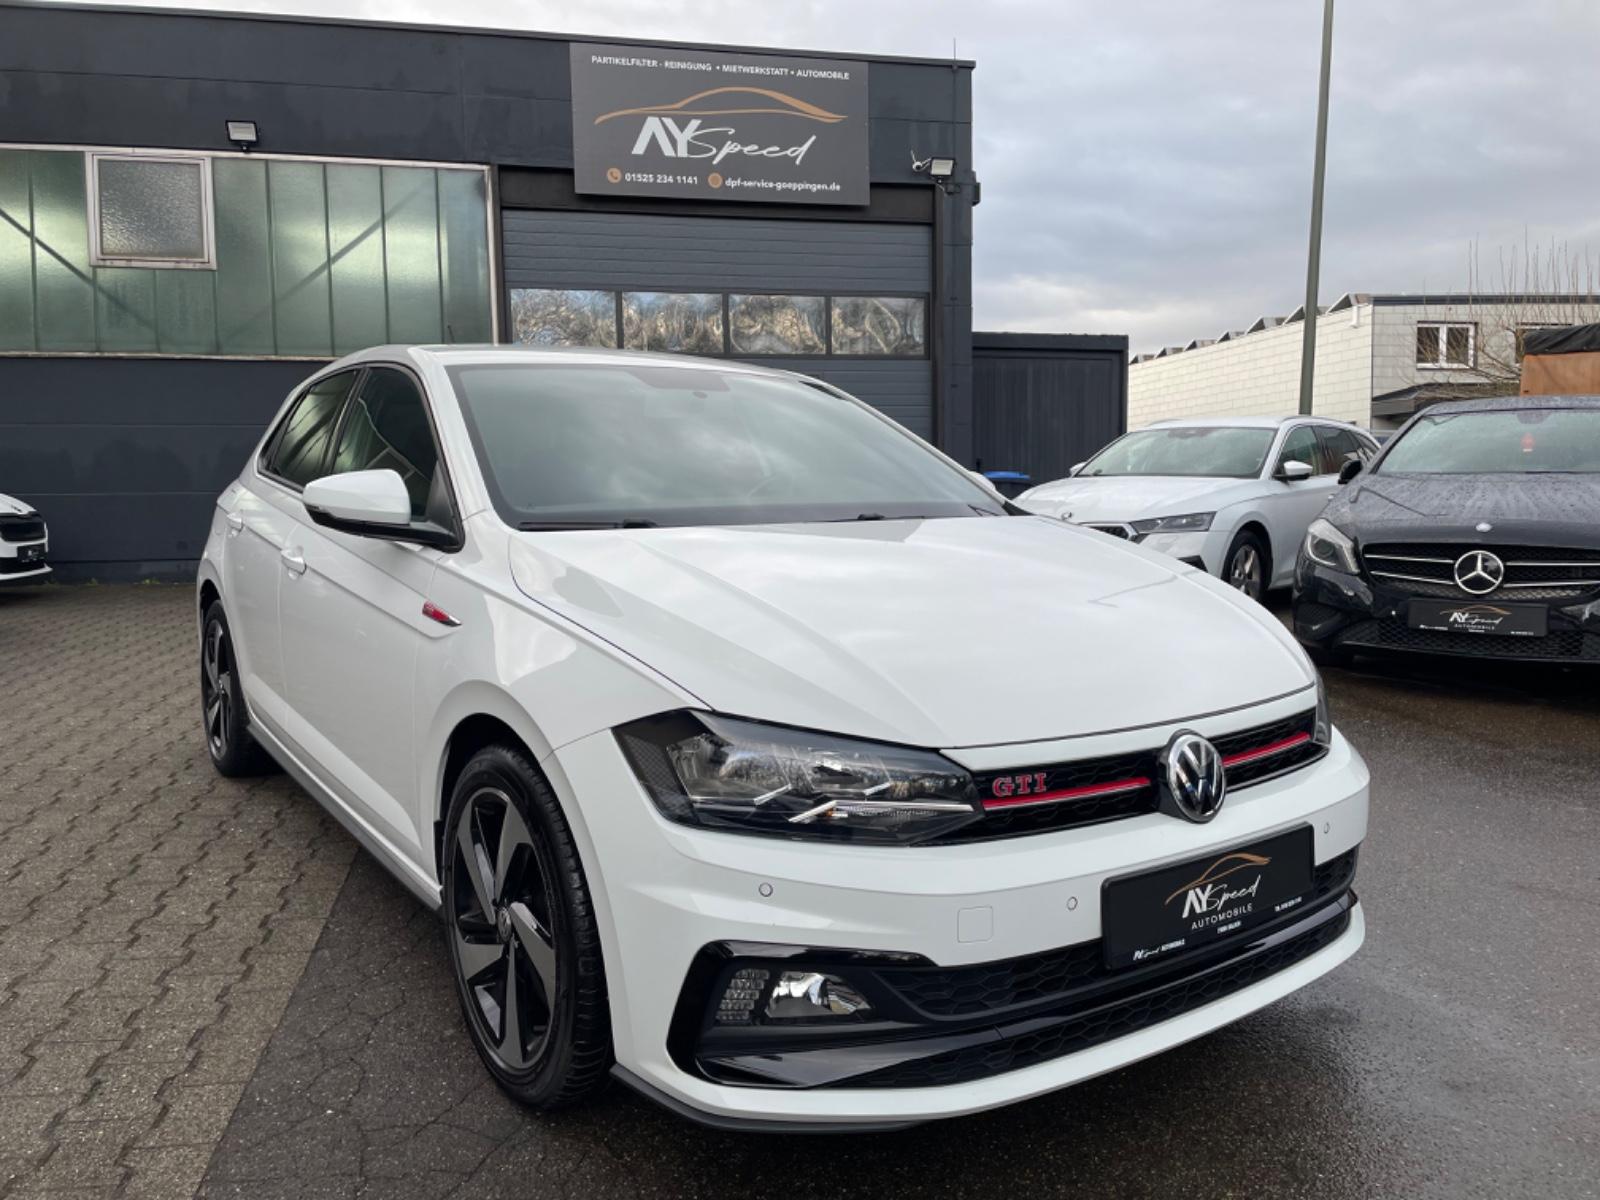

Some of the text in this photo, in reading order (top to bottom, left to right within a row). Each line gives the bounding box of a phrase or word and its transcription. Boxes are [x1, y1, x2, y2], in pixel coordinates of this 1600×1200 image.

[796, 69, 850, 80] AUTOMOBILE
[656, 174, 674, 184] 234
[676, 175, 698, 185] 1141
[992, 772, 1047, 797] GTI
[1191, 902, 1253, 930] AUTOMOBILE
